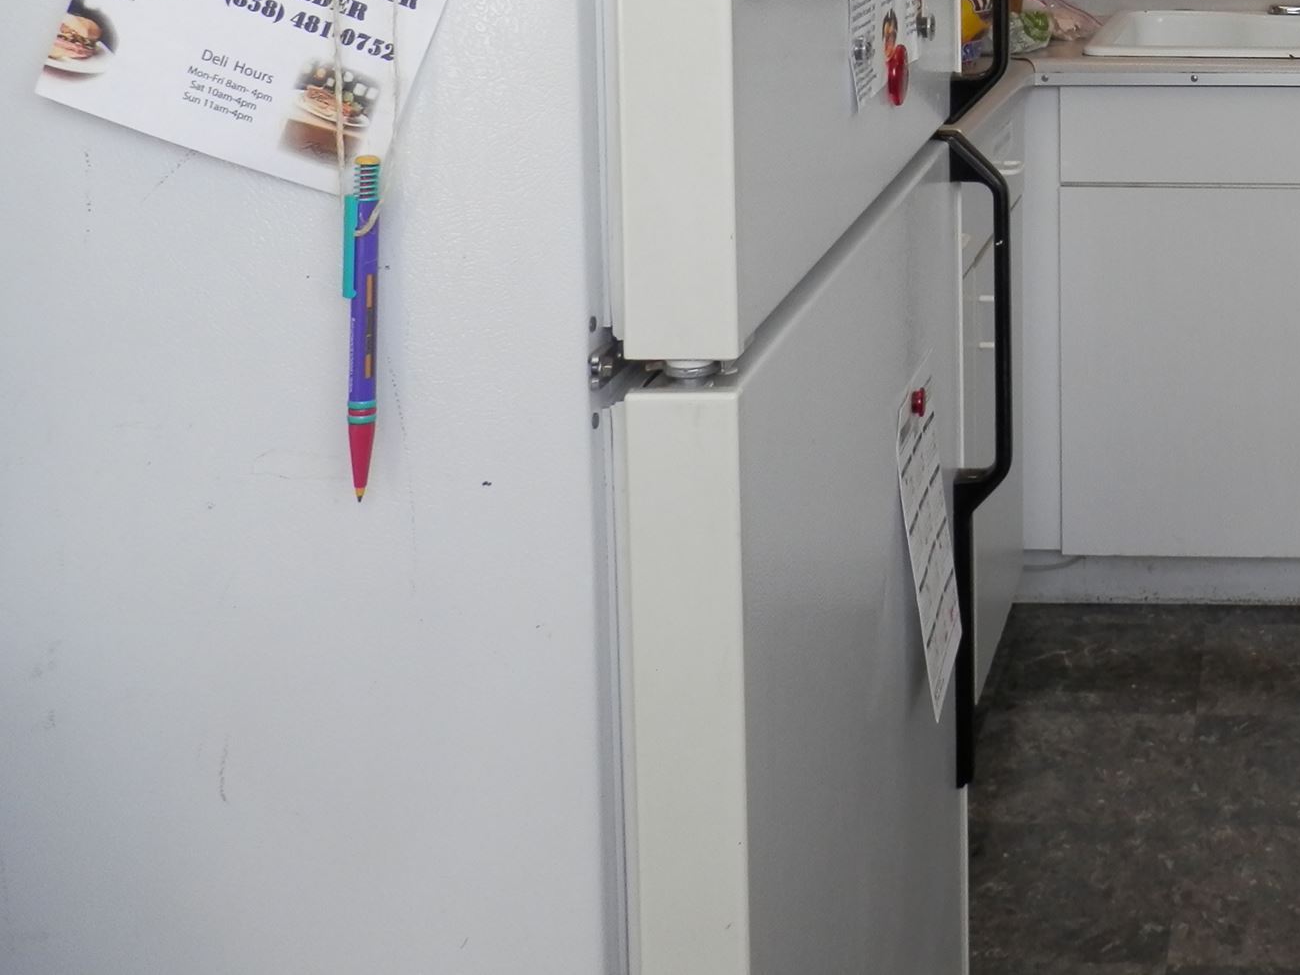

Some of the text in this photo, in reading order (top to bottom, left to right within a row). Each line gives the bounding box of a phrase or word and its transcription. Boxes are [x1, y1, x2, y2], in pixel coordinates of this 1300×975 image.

[290, 11, 396, 62] 4810752
[201, 49, 274, 84] Deli Hours
[187, 66, 225, 84] Mon-Fri
[251, 89, 273, 103] 4pm
[190, 80, 257, 111] Sat 10am-4pm
[182, 91, 253, 123] Sun 11am-4pm
